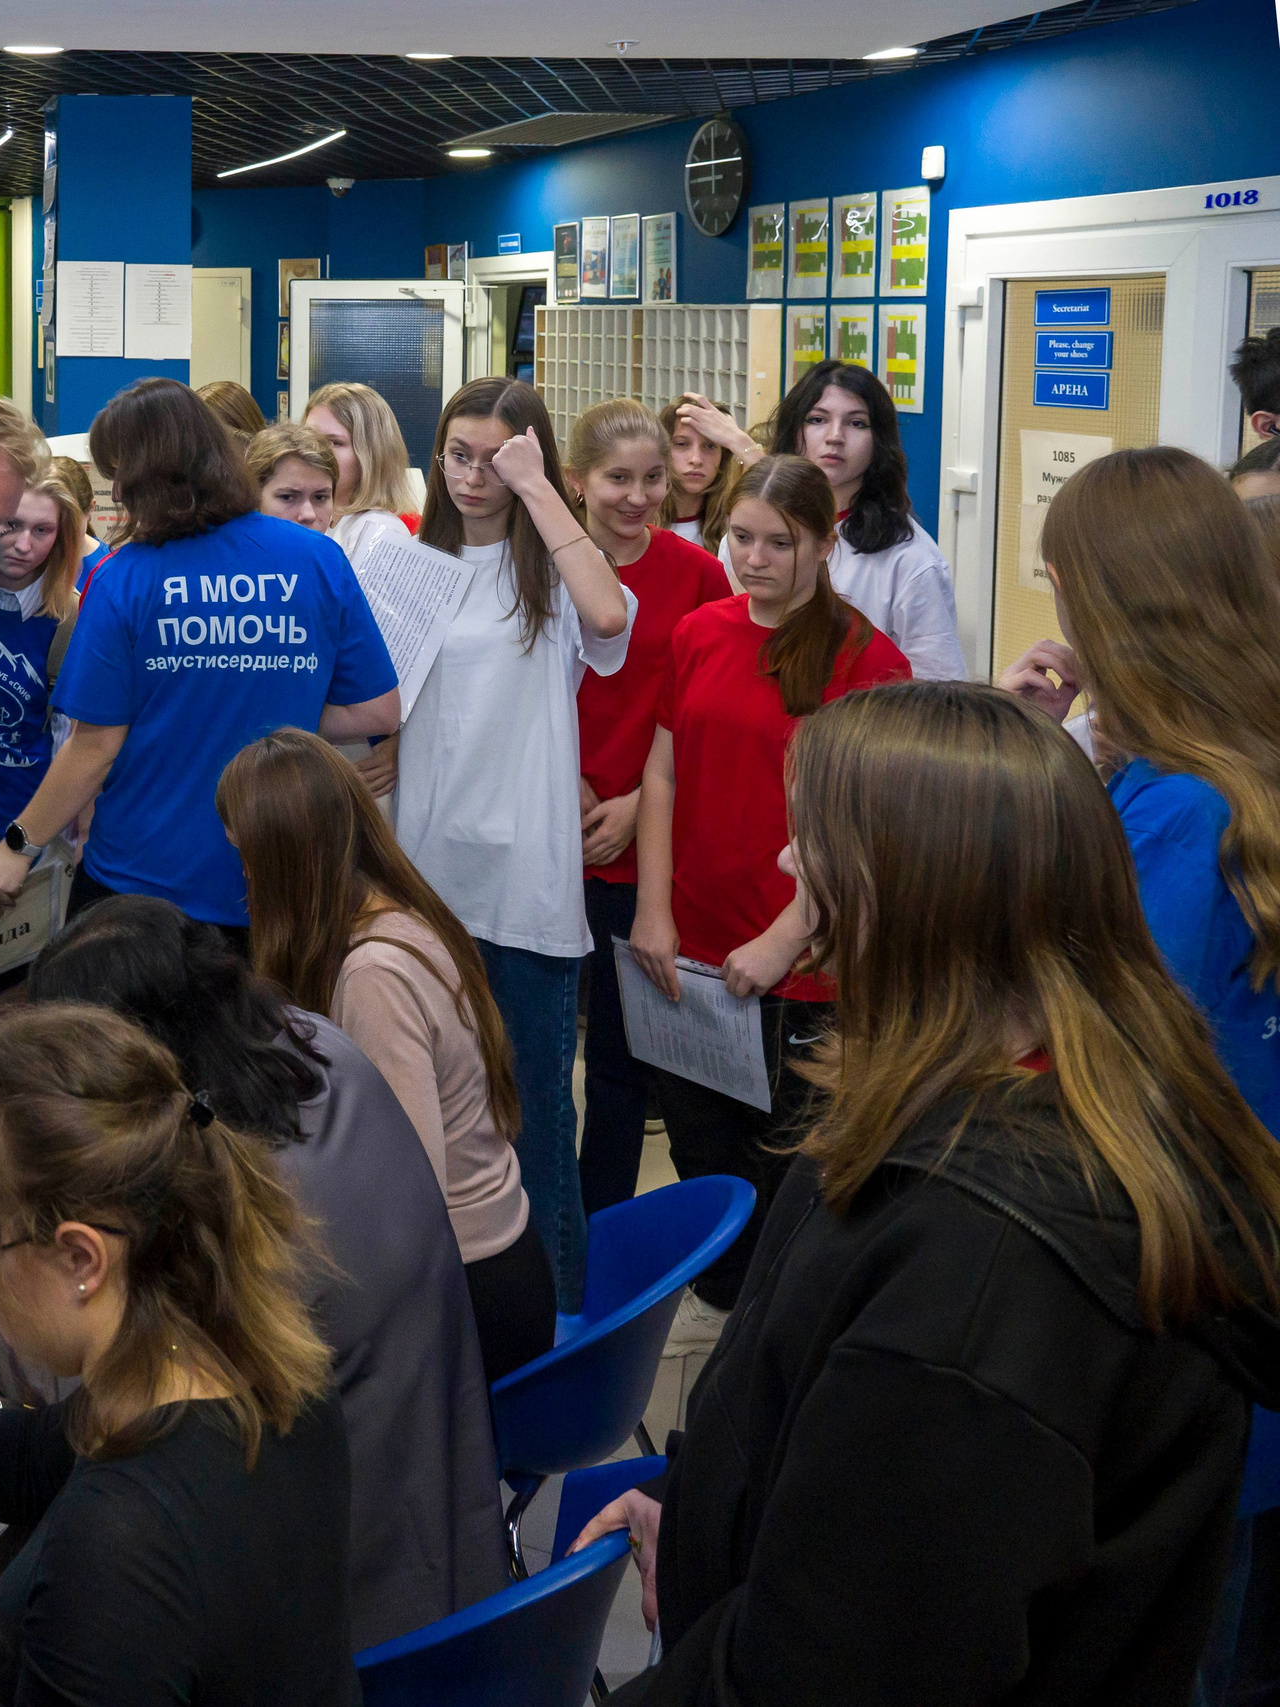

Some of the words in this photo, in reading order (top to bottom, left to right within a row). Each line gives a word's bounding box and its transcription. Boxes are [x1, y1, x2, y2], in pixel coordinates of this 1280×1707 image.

[1204, 189, 1259, 209] 1018
[1052, 303, 1090, 313] Secretariat
[1071, 340, 1095, 351] change
[1054, 352, 1069, 360] your
[1070, 350, 1088, 359] shoes
[1051, 384, 1089, 396] АРЕНА
[1052, 450, 1076, 463] 1085
[163, 576, 188, 605] Я
[200, 573, 298, 603] МОГУ
[157, 614, 308, 646] ПОМОЧЬ
